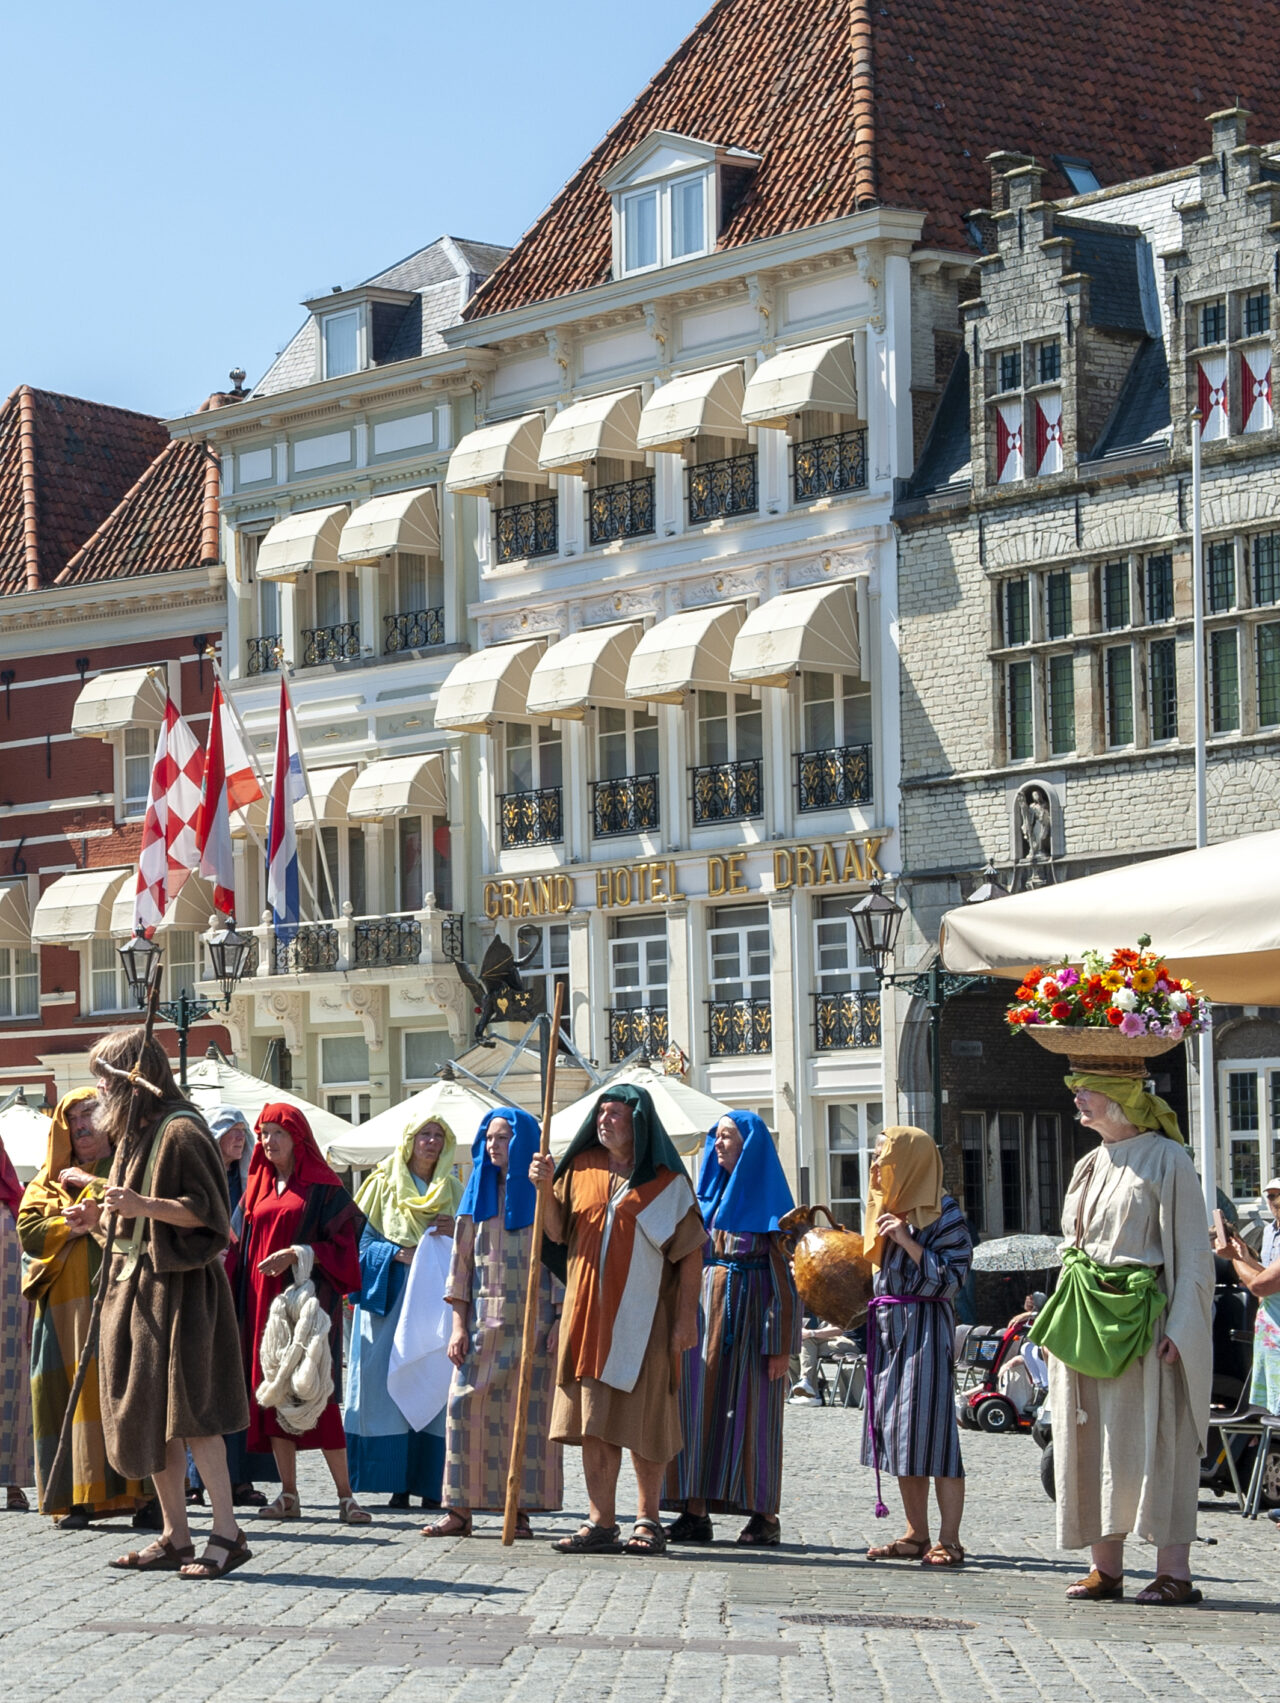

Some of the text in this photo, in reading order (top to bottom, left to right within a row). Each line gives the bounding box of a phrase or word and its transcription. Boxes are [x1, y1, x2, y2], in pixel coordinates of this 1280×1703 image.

[484, 837, 885, 920] GRAND HOTEL DE DRAAK
